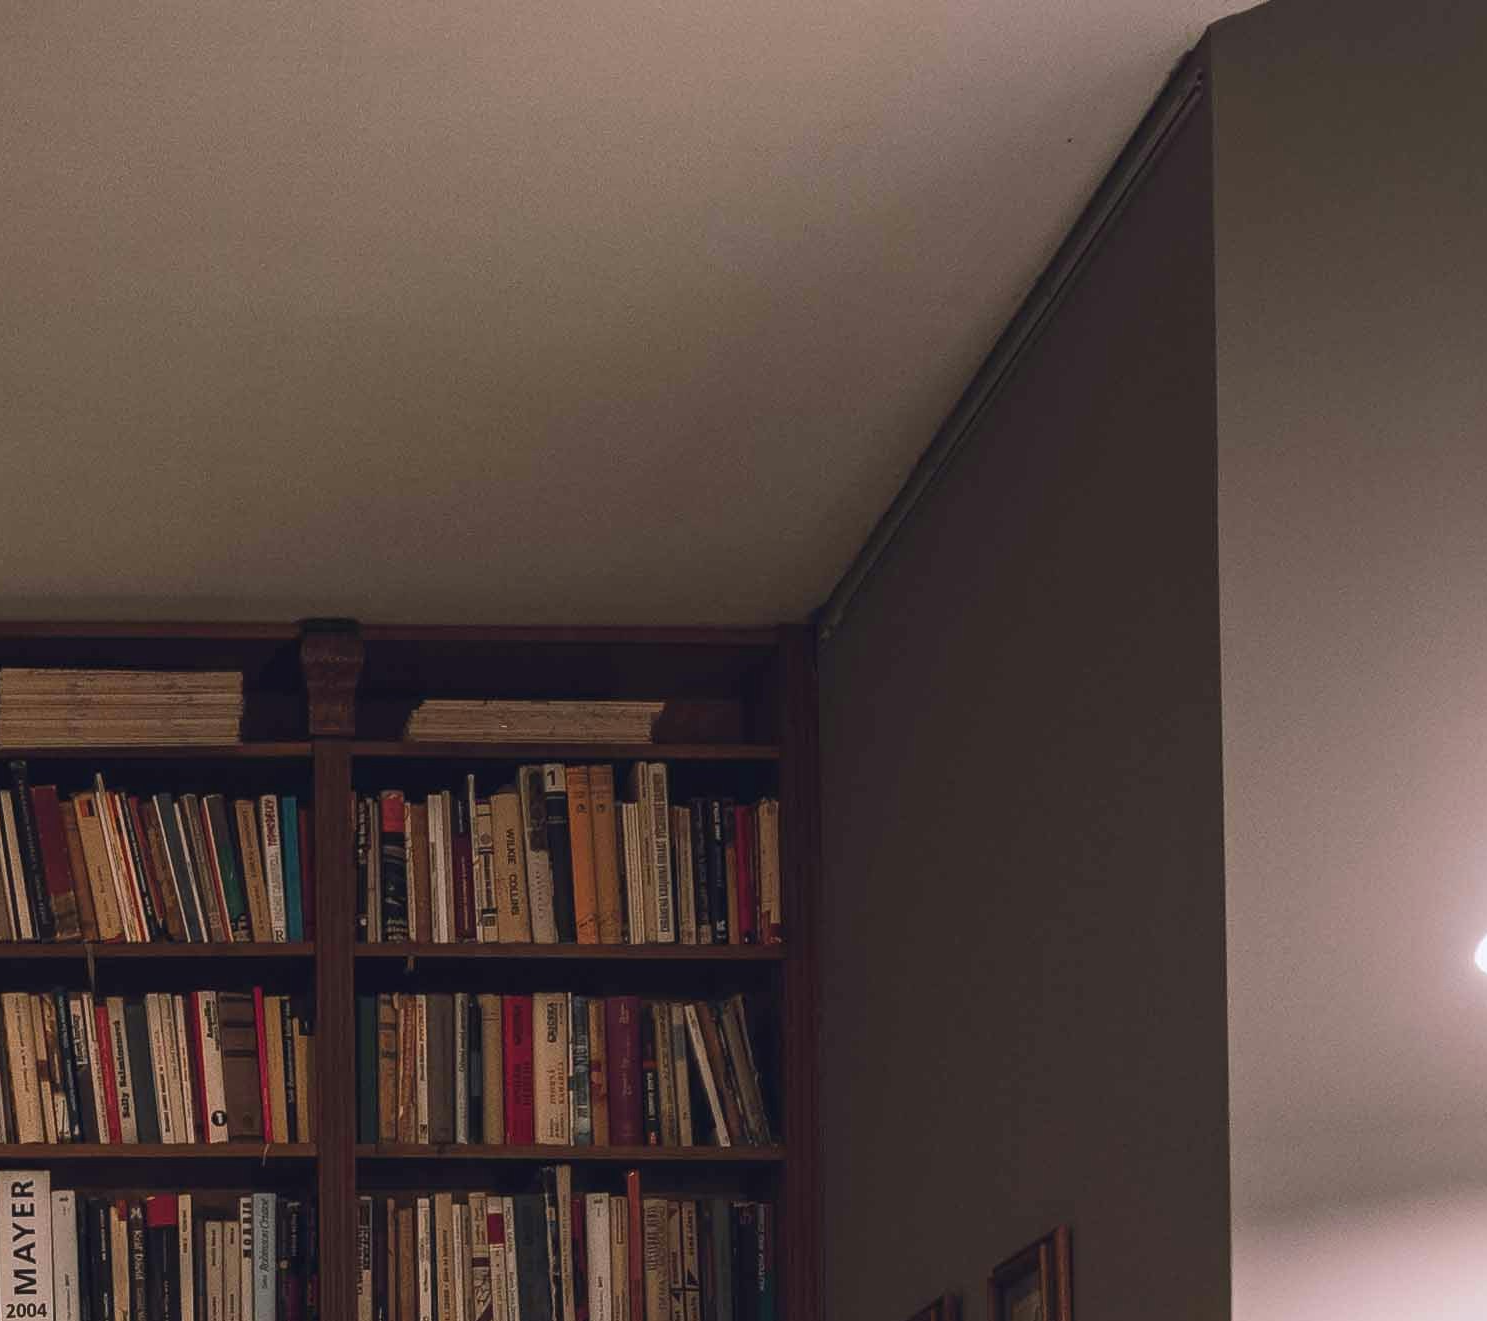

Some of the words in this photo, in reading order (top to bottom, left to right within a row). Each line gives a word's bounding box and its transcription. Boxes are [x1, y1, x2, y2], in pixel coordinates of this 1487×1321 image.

[509, 874, 519, 916] COLLINS
[13, 1180, 35, 1294] MAYER
[6, 1302, 47, 1319] 2004
